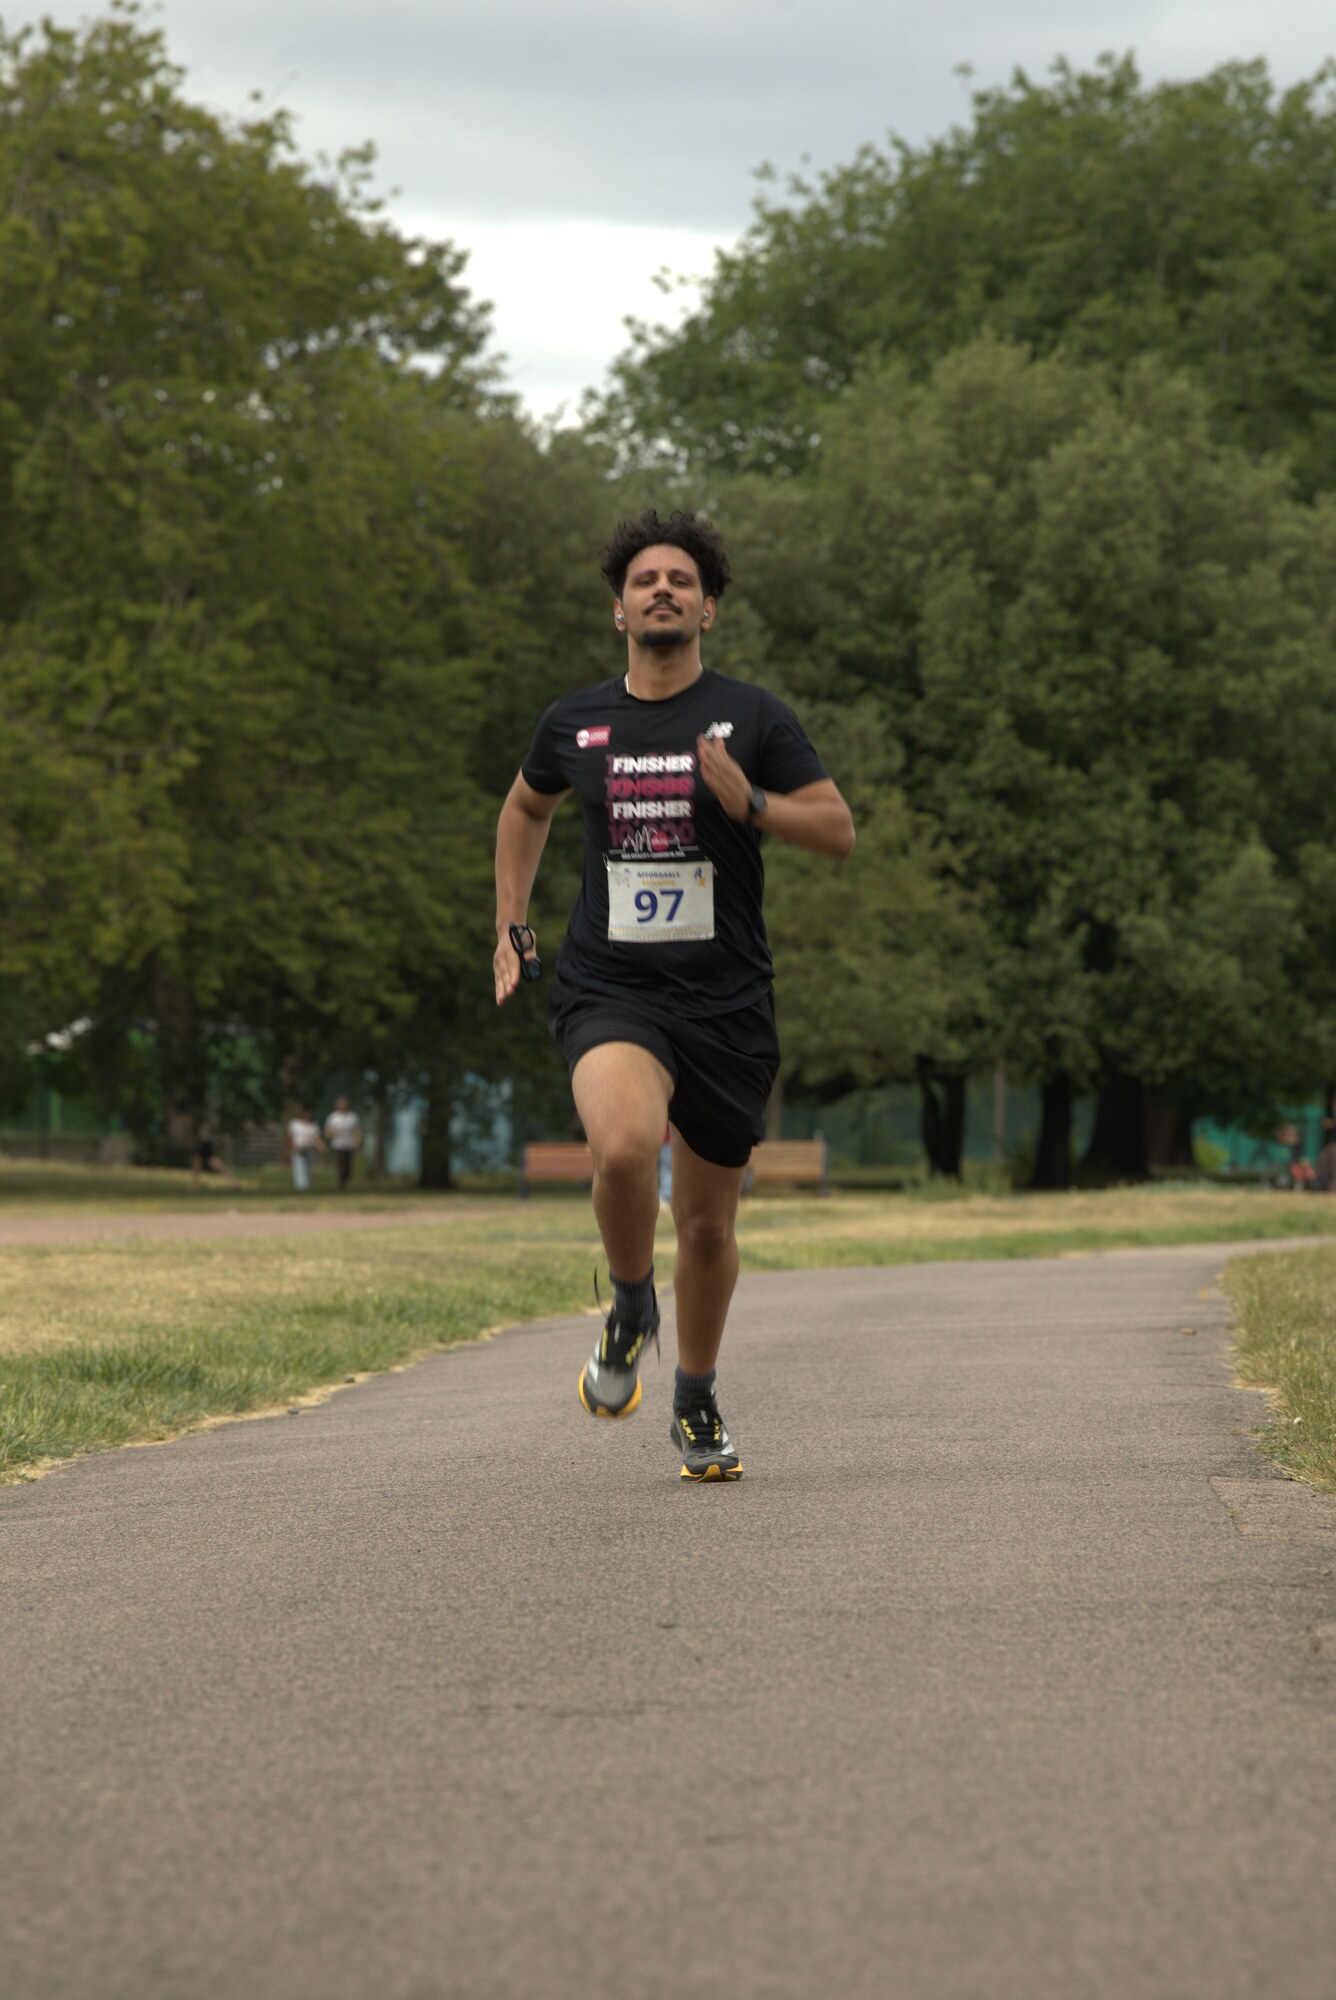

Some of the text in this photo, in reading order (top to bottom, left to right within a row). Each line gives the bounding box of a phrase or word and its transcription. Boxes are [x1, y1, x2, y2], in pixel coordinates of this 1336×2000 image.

[612, 755, 693, 774] FINISHER
[612, 800, 692, 819] FINISHER
[634, 889, 684, 924] 97
